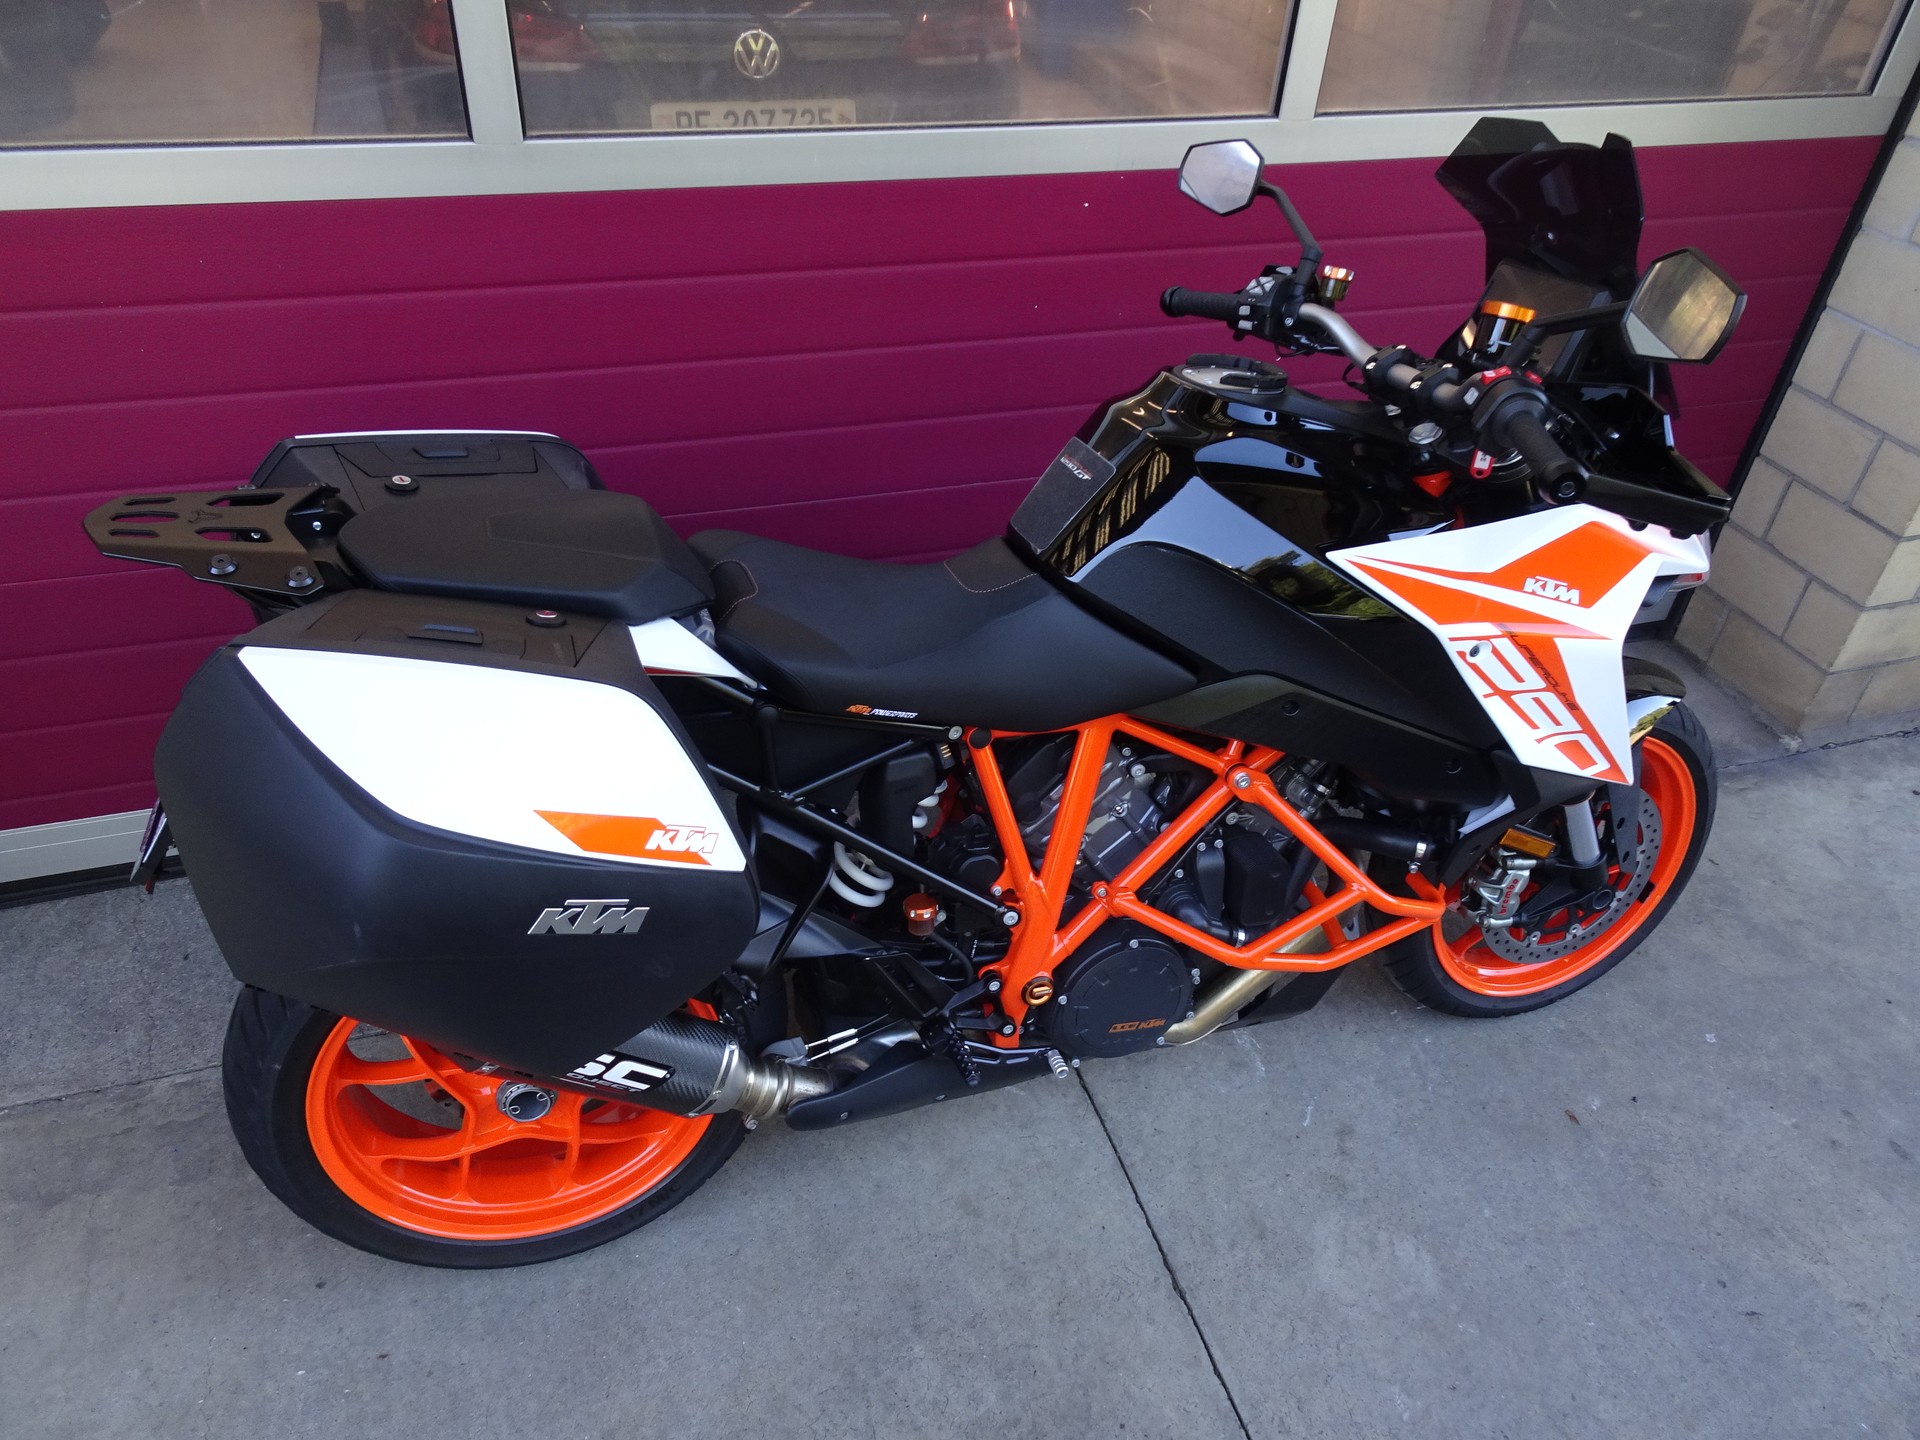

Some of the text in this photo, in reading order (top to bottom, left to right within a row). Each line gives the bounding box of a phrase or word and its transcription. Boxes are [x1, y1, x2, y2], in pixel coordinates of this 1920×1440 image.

[1522, 575, 1580, 605] KTM
[644, 823, 720, 854] KTM
[1496, 878, 1519, 915] brembo
[527, 898, 650, 935] KTM
